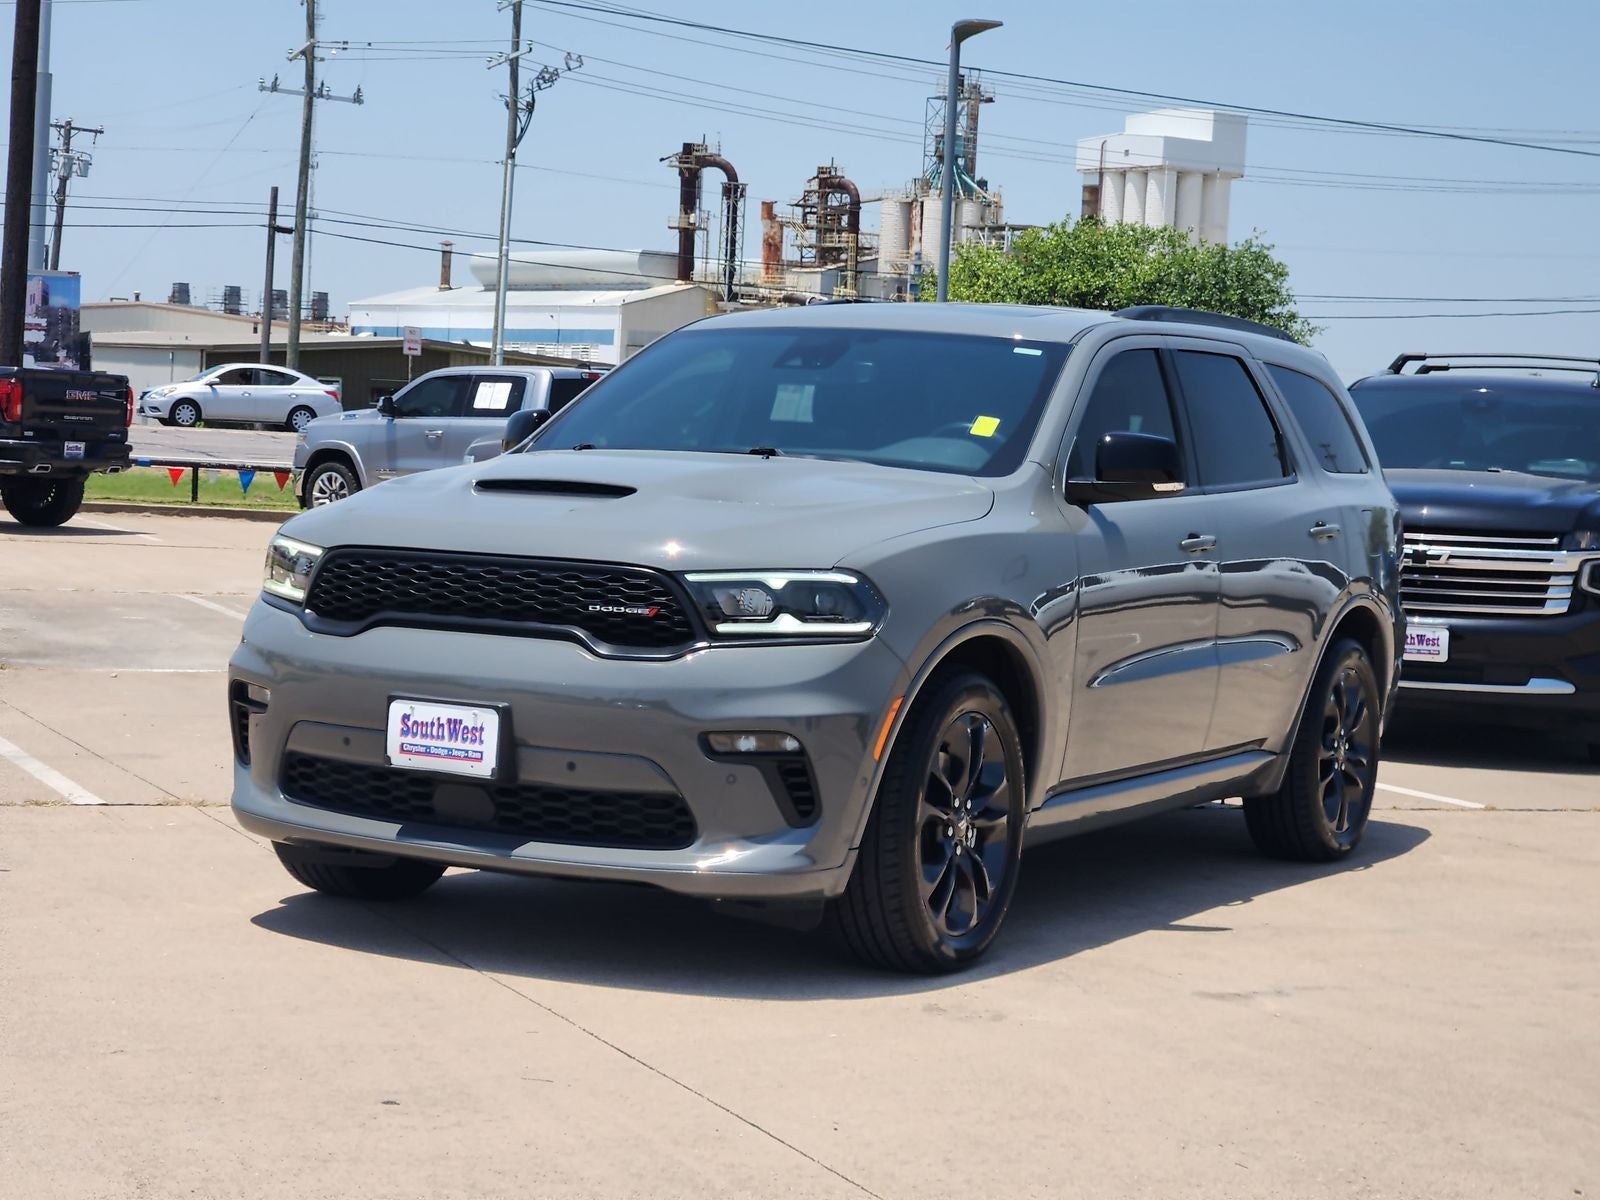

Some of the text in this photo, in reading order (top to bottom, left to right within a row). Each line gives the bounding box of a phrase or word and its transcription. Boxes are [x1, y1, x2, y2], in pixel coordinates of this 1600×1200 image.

[66, 389, 98, 400] GMC
[400, 713, 485, 745] SouthWest
[402, 743, 481, 759] Chrysler Dodge Jeep Ram
